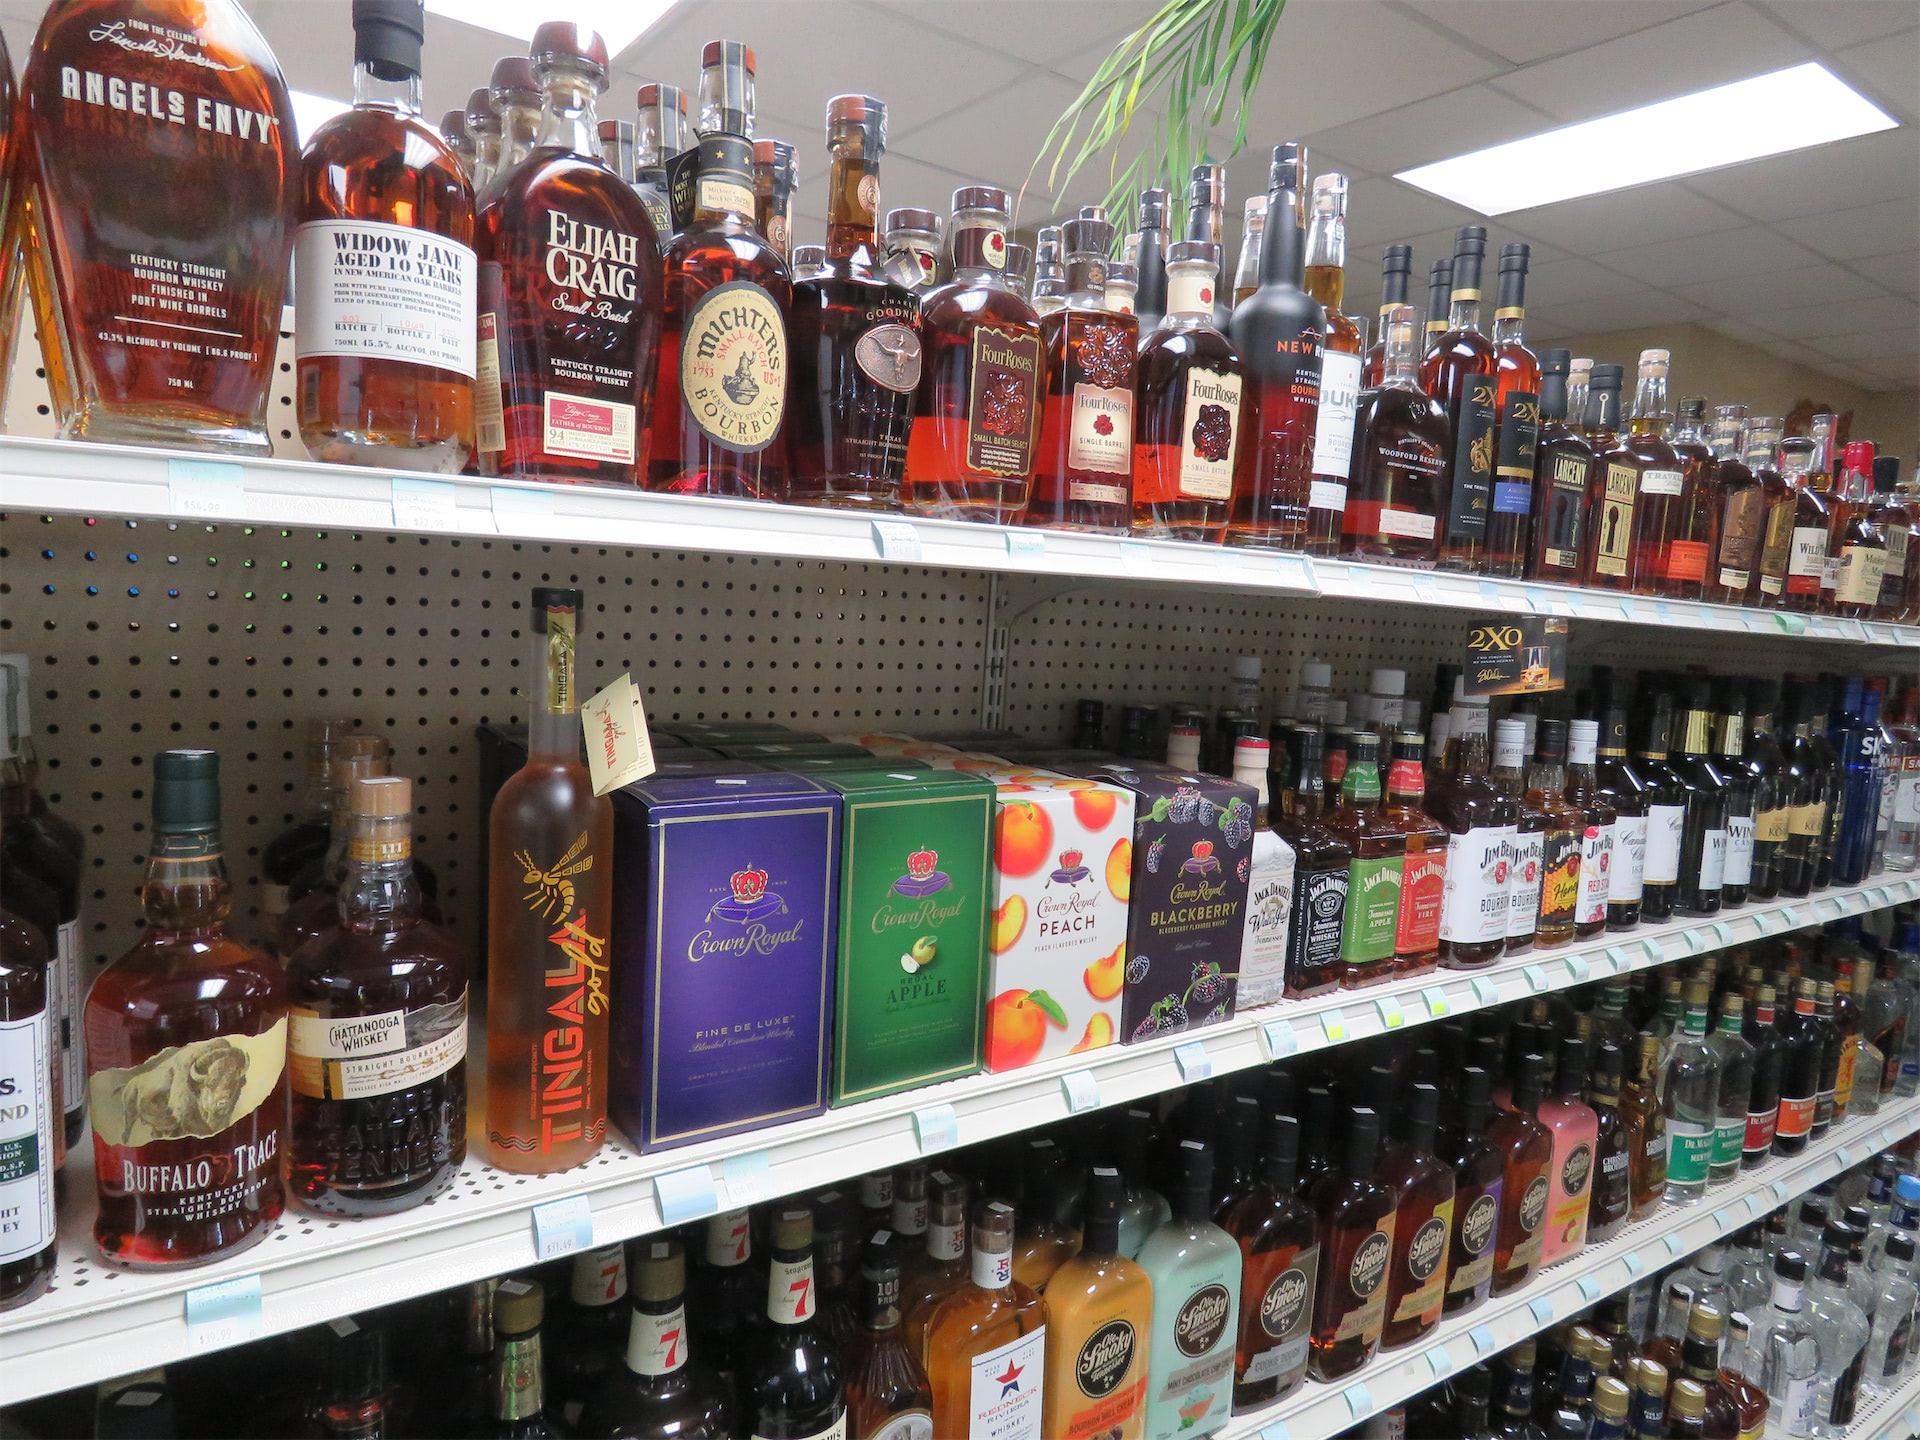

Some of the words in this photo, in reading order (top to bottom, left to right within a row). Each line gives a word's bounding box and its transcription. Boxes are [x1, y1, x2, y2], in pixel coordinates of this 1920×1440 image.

[128, 19, 149, 31] FROM
[151, 25, 164, 36] THE
[166, 29, 197, 45] CELLARS
[61, 66, 186, 125] ANGELS
[197, 97, 272, 145] ENVY
[547, 208, 639, 268] ELIJAH
[334, 232, 412, 256] WIDOW
[418, 244, 462, 272] JANE
[130, 253, 179, 271] KENTUCKY
[182, 262, 226, 280] STRAIGHT
[334, 252, 381, 268] AGED
[389, 256, 411, 272] 10
[416, 261, 462, 287] YEARS
[546, 248, 637, 302] CRAIG
[134, 267, 179, 284] BOURBON
[182, 276, 224, 292] WHISKEY
[334, 268, 344, 276] IN
[345, 268, 364, 276] NEW
[366, 270, 412, 282] AMERICAN
[414, 276, 431, 287] OAK
[433, 280, 462, 296] BARRELS
[151, 283, 194, 300] FINISHED
[198, 291, 208, 302] IN
[366, 300, 402, 309] STRAIGHT
[131, 294, 156, 308] PORT
[159, 298, 184, 312] WINE
[186, 302, 227, 319] BARRELS
[552, 292, 587, 316] Small
[590, 301, 632, 324] Batch
[335, 324, 368, 332] BATCH
[387, 328, 423, 339] BOTTLE
[98, 332, 124, 343] 43.3%
[126, 334, 159, 348] ALCOHOL
[161, 340, 171, 349] BY
[173, 342, 202, 354] VOLUME
[230, 349, 252, 360] PROOF
[362, 339, 392, 349] 45.5%
[396, 344, 427, 354] ALC/VOL
[442, 338, 459, 348] DATE
[717, 330, 745, 360] SMALL
[748, 332, 768, 368] BATCH
[1276, 340, 1313, 354] NEW
[550, 358, 593, 372] KENTUCKY
[596, 365, 632, 379] STRAIGHT
[554, 368, 593, 382] BOURBON
[596, 375, 629, 388] WHISKEY
[693, 366, 714, 378] 1753
[710, 388, 743, 421] KENTUCKY
[1192, 379, 1218, 399] Four
[1216, 384, 1238, 405] Roses
[695, 388, 779, 434] BOURBON
[549, 428, 564, 440] 94
[551, 418, 575, 428] FATHER
[582, 423, 611, 432] BOURBON
[974, 433, 992, 444] SMALL
[994, 436, 1010, 447] BATCH
[1080, 437, 1102, 446] SINGLE
[1104, 439, 1126, 448] BARREL
[1191, 463, 1214, 473] SMALL
[1378, 447, 1418, 460] WOODFORD
[1420, 454, 1447, 468] RESERVE
[1554, 458, 1588, 486] LARCENY
[1607, 470, 1636, 496] LARCENY
[1468, 626, 1523, 652] 2XO
[557, 650, 568, 704] TINGALA
[602, 714, 617, 770] TINGALA
[1480, 845, 1500, 869] JIM
[1514, 846, 1529, 866] JIM
[1556, 844, 1572, 864] JIM
[1586, 840, 1604, 860] JIM
[1364, 872, 1381, 892] JACK
[1410, 866, 1427, 886] JACK
[1587, 880, 1600, 893] RED
[1170, 883, 1198, 905] Crown
[1190, 880, 1227, 902] Royal
[1254, 886, 1270, 906] JACK
[1309, 880, 1327, 902] JACK
[1326, 876, 1349, 898] DANIEL'S
[871, 904, 920, 934] Crown
[916, 896, 966, 928] Royal
[1037, 896, 1070, 918] Crown
[1067, 891, 1101, 914] Royal
[1150, 902, 1238, 927] BLACKBERRY
[1368, 909, 1394, 920] Tennessee
[1418, 910, 1434, 919] FIRE
[1040, 914, 1096, 938] PEACH
[1158, 926, 1188, 936] BLACKBERRY
[1189, 922, 1212, 932] FLAVORED
[1368, 918, 1392, 928] APPLE
[688, 929, 746, 962] Crown
[734, 918, 804, 958] Royal
[1034, 945, 1052, 953] PEACH
[1052, 940, 1078, 950] FLAVORED
[1079, 936, 1098, 946] WHISKY
[1310, 931, 1340, 944] WHISKEY
[886, 978, 948, 1005] APPLE
[900, 974, 935, 985] REGAL
[329, 1016, 400, 1047] CHATTANOOGA
[542, 914, 587, 1154] TINGALA
[688, 1037, 726, 1054] Blended
[726, 1033, 766, 1048] Canadian
[766, 1027, 796, 1043] Whisky
[696, 1027, 728, 1040] FINE
[734, 1022, 752, 1033] DE
[757, 1016, 790, 1029] LUXE
[342, 1030, 390, 1054] WHISKEY
[346, 1060, 394, 1074] STRAIGHT
[399, 1046, 440, 1064] BOURBON
[123, 1159, 210, 1193] BUFFALO
[234, 1129, 278, 1179] TRACE
[4, 1170, 17, 1180] KY
[147, 1201, 214, 1216] STRAIGHT
[220, 1177, 268, 1206] BOURBON
[179, 1182, 245, 1206] KENTUCKY
[184, 1201, 242, 1222] WHISKEY
[1464, 1204, 1496, 1234] Smoky
[730, 1222, 748, 1260] 7
[1410, 1228, 1446, 1260] Smoky
[1352, 1242, 1390, 1276] Smoky
[601, 1263, 620, 1299] 7
[878, 1281, 900, 1297] 100
[789, 1278, 810, 1318] 7
[1199, 1296, 1215, 1312] Ole
[1263, 1280, 1307, 1315] Smoky
[1178, 1294, 1228, 1335] Smoky
[660, 1328, 680, 1368] 7
[1080, 1330, 1133, 1374] Smoky
[1102, 1334, 1119, 1347] Ole
[1254, 1356, 1278, 1372] COOKIE
[1168, 1379, 1182, 1392] MINT
[1182, 1367, 1211, 1386] CHOCOLATE
[978, 1384, 1038, 1420] REDNECK
[986, 1399, 1030, 1424] RIVIERA
[990, 1415, 1026, 1438] WHISKEY
[1070, 1416, 1100, 1434] BOURBON
[1102, 1410, 1114, 1420] BALL
[1116, 1396, 1135, 1414] CREAM
